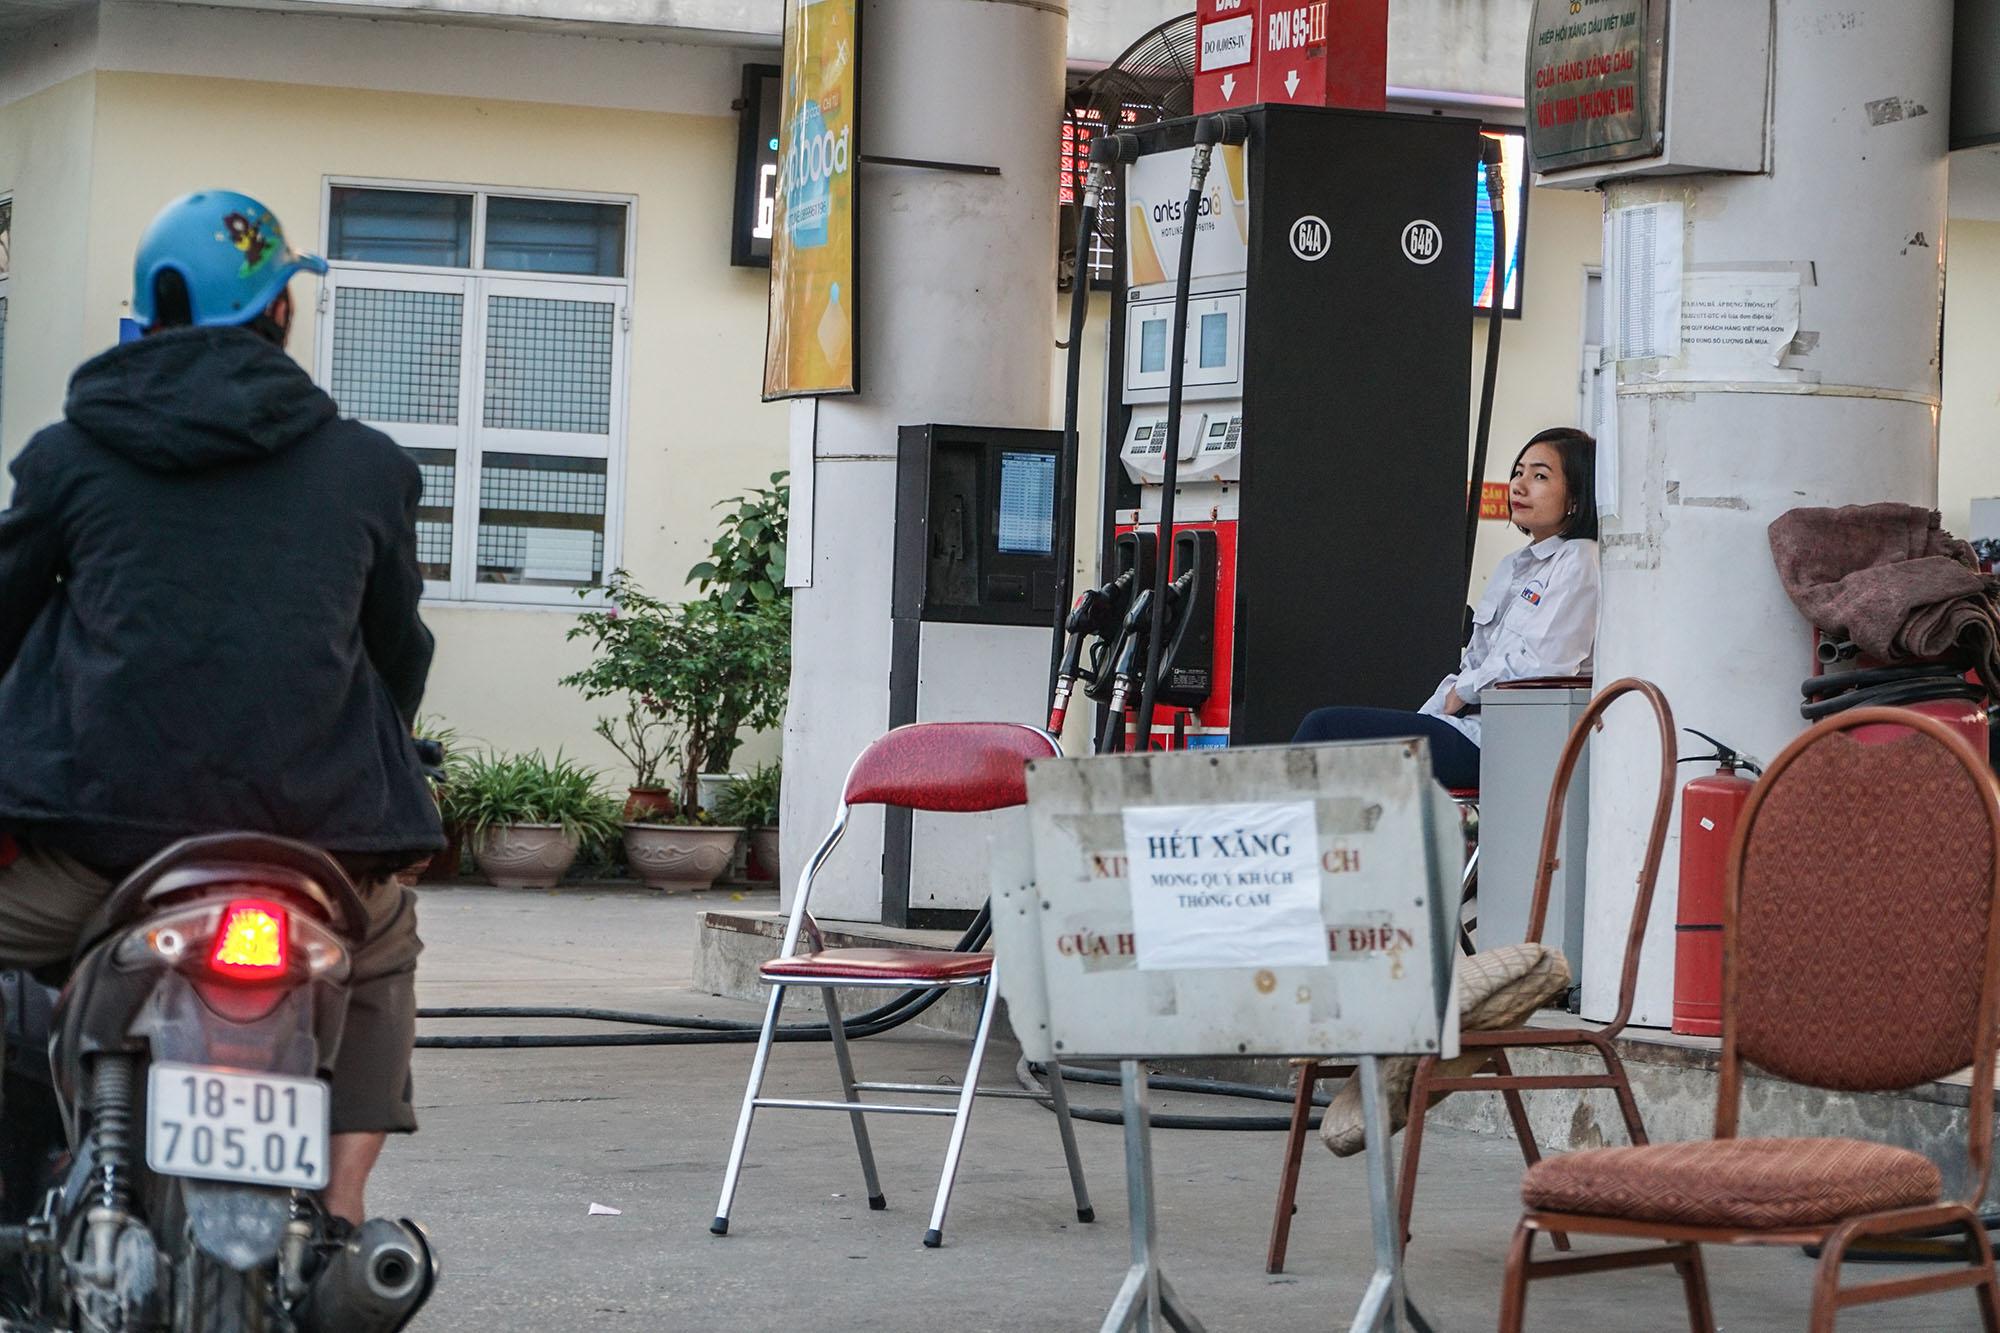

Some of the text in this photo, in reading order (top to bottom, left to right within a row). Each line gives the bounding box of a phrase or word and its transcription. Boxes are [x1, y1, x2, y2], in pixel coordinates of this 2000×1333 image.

[1268, 3, 1327, 51] RON 95-III
[1620, 12, 1635, 27] NAM
[1204, 40, 1215, 54] DO
[1556, 59, 1583, 82] HÀNG
[1153, 199, 1181, 223] ants
[1298, 223, 1321, 252] 64A
[1409, 226, 1433, 256] 64B
[1482, 504, 1497, 515] NO
[1147, 829, 1292, 859] HẾT XĂNG
[1151, 873, 1199, 888] MONG
[182, 1075, 298, 1128] 18-D1
[161, 1121, 316, 1178] 705.04
